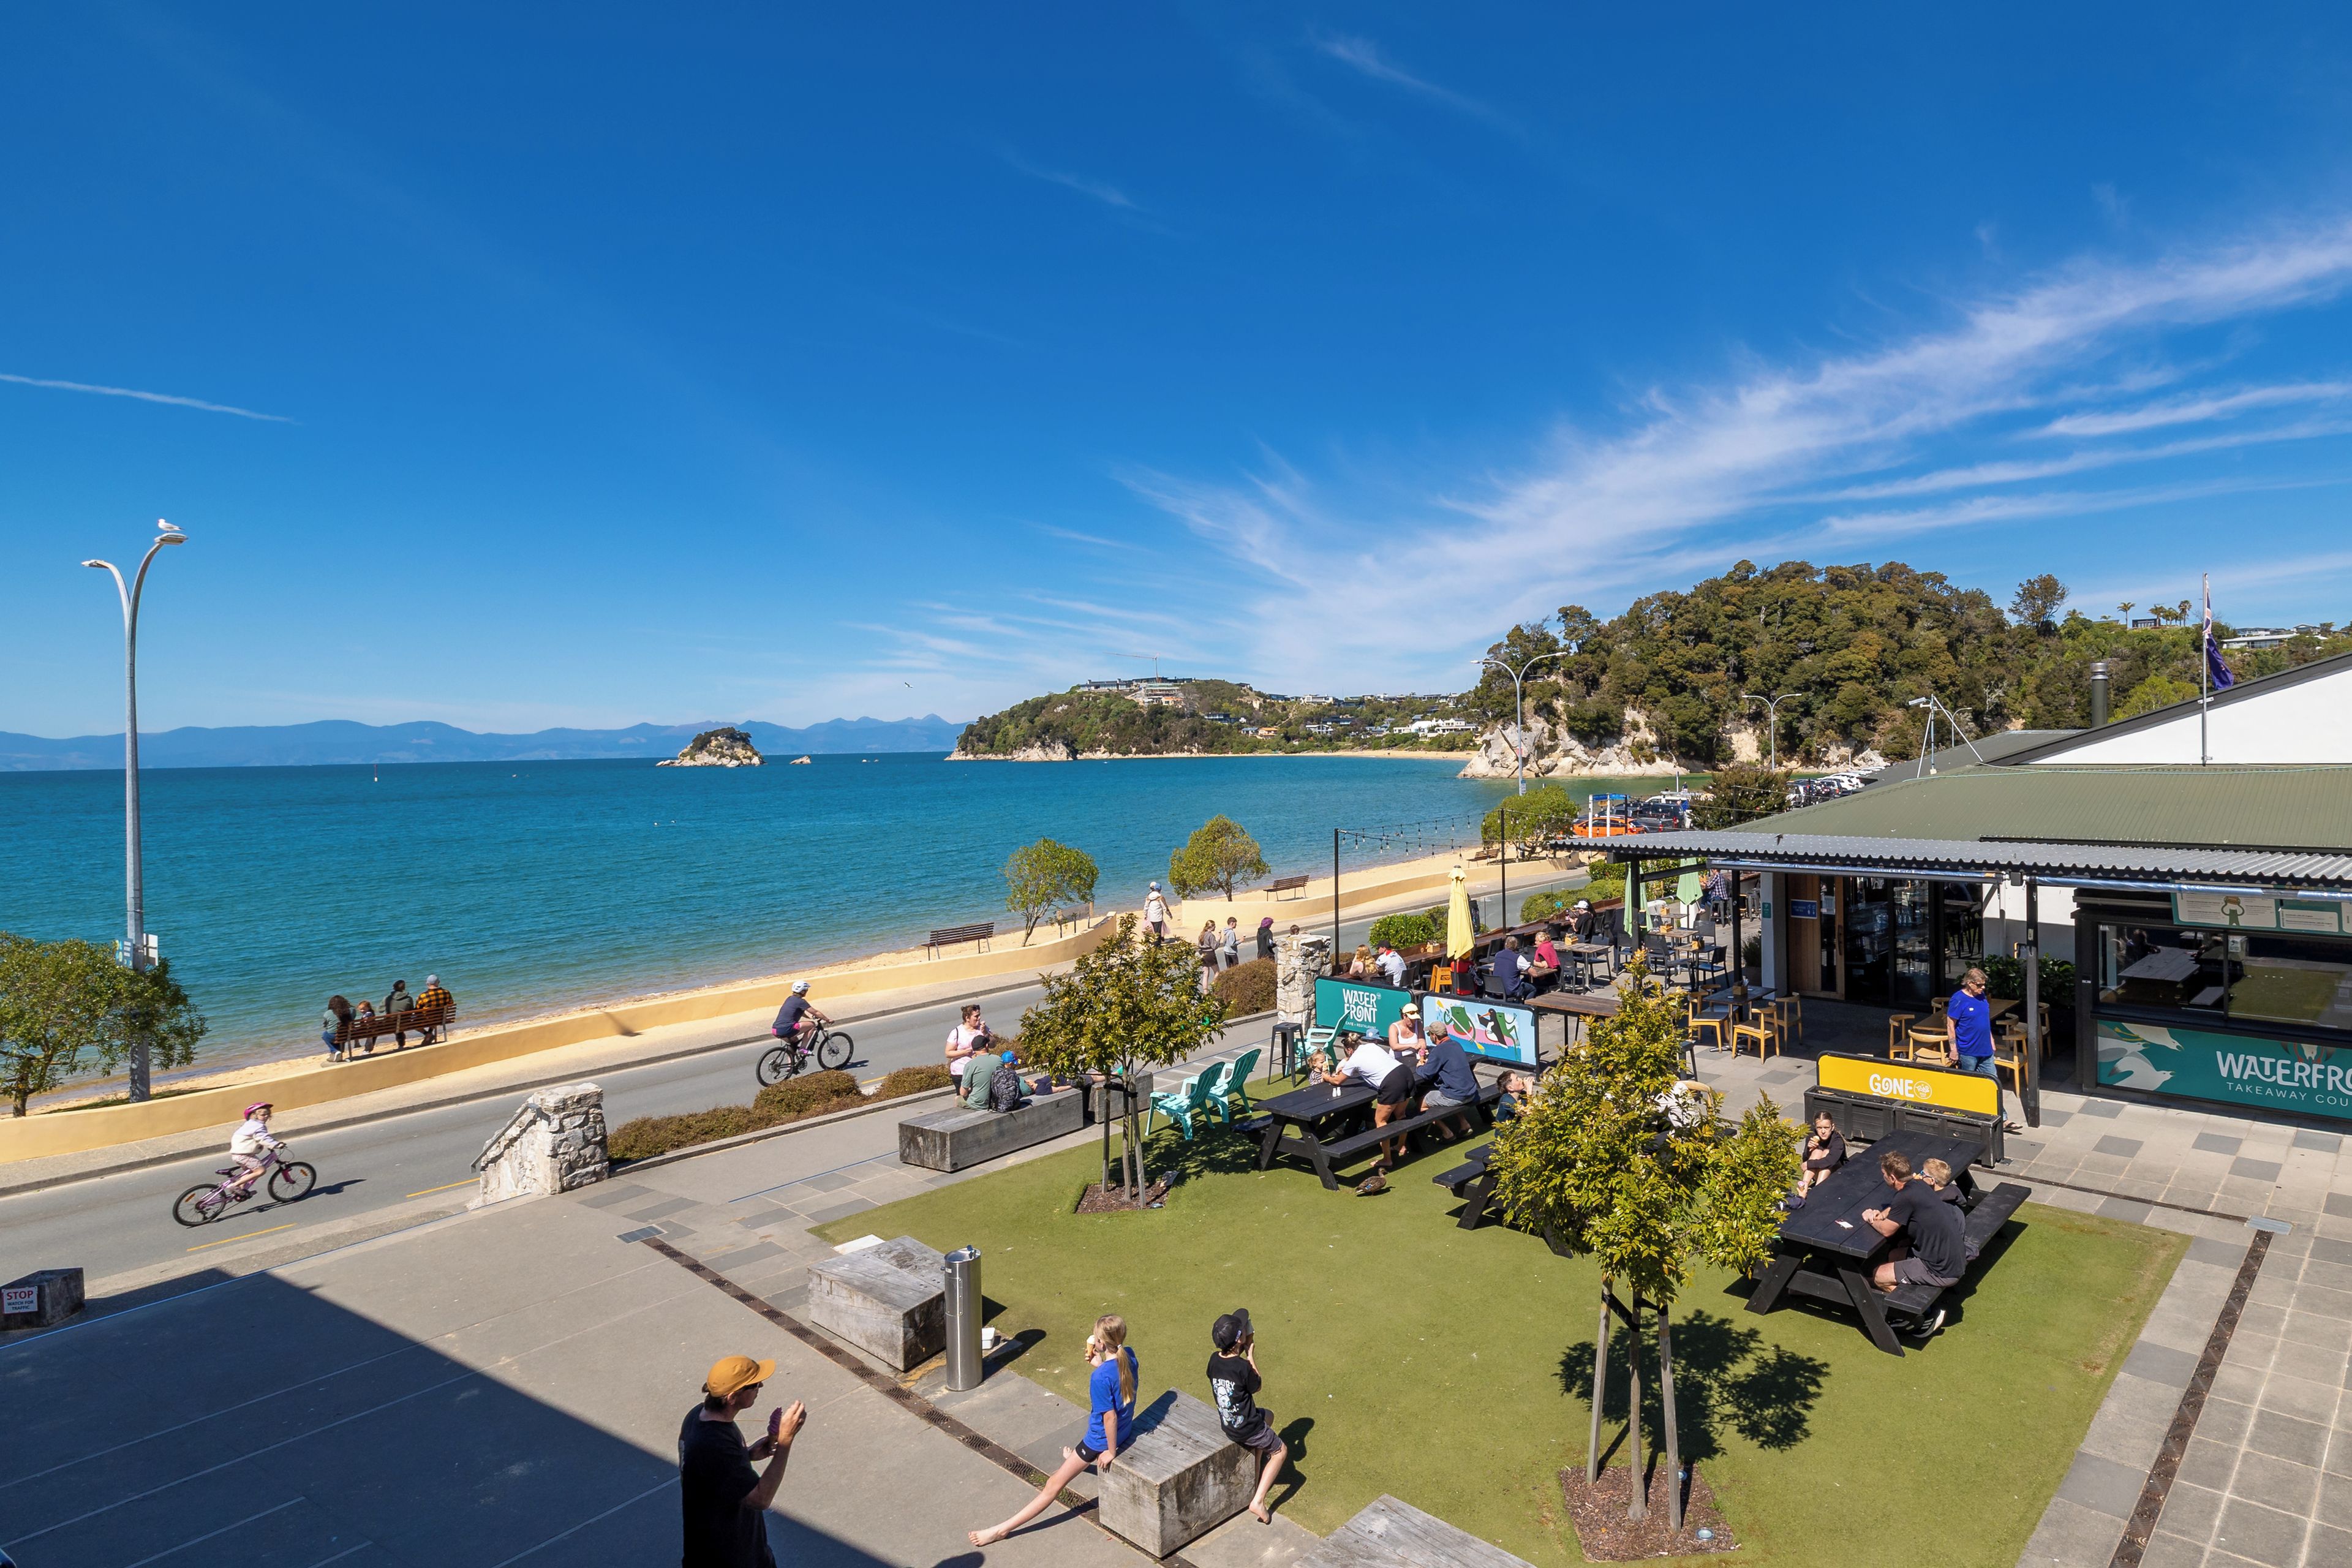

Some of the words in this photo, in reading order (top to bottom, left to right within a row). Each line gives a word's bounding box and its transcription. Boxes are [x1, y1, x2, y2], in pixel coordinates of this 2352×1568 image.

[1343, 988, 1377, 1008] WATER
[1344, 1003, 1378, 1023] FRONT
[1869, 1074, 1914, 1098] GONE
[2226, 1082, 2307, 1101] TAKEAWAY
[2315, 1095, 2352, 1107] COU
[7, 1291, 33, 1300] STOP
